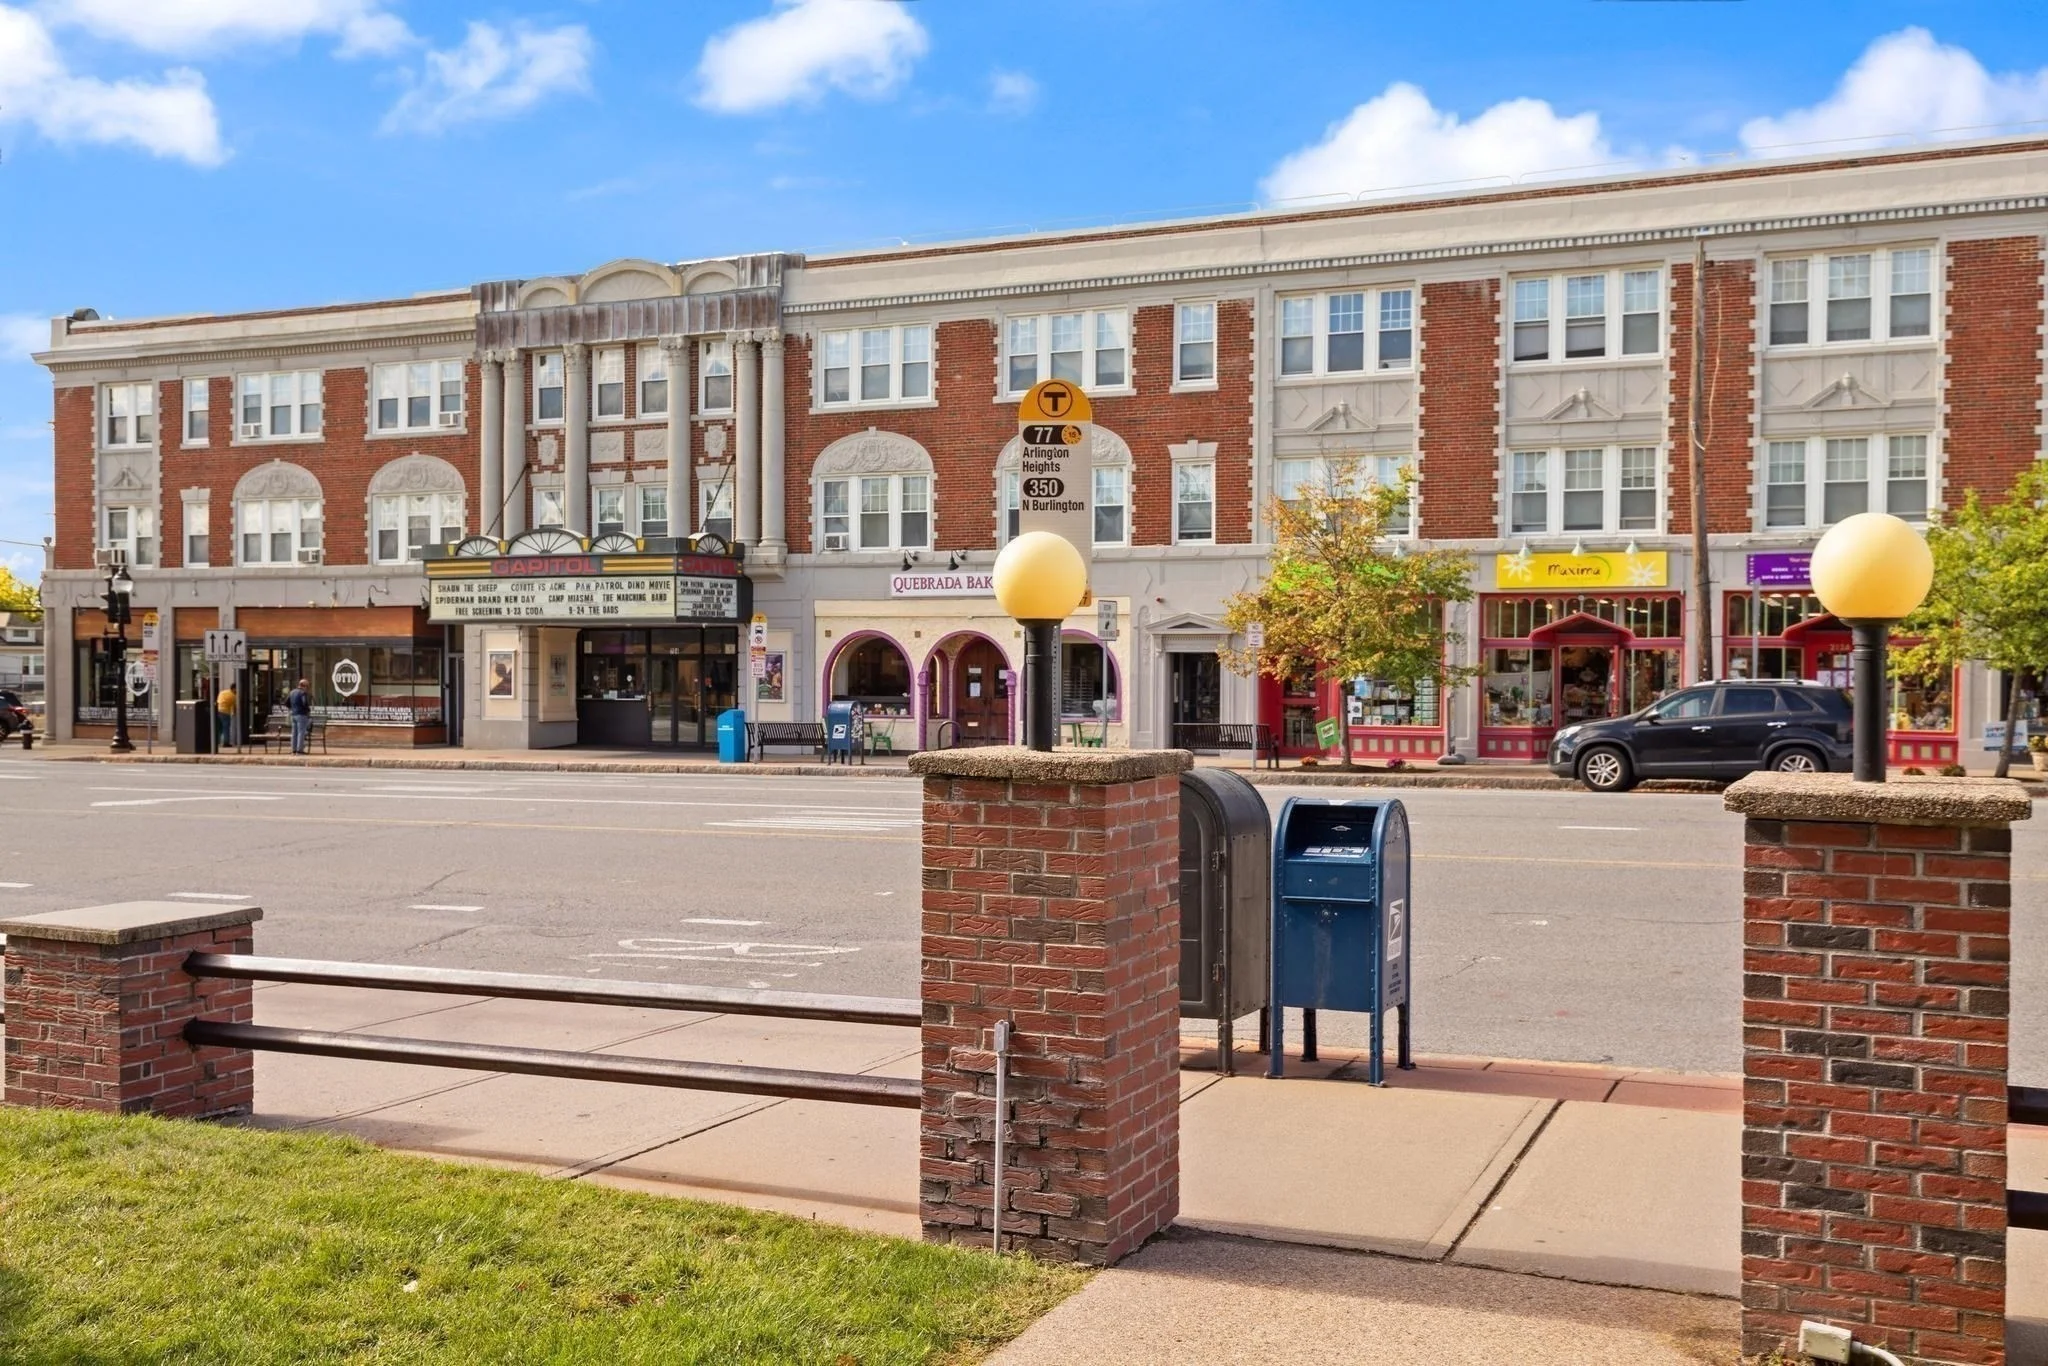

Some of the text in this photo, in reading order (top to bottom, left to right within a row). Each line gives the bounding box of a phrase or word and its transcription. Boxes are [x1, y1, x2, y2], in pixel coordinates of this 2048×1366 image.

[1043, 391, 1067, 412] T
[1034, 427, 1054, 443] 77
[1022, 447, 1069, 460] Arlington
[1022, 461, 1061, 474] Heights
[1029, 479, 1058, 497] 350
[1022, 500, 1084, 513] N Burlington
[492, 557, 597, 576] CAPITOL
[1548, 563, 1600, 577] Maxima
[438, 583, 460, 592] SHAUN
[464, 583, 474, 592] THE
[477, 583, 498, 592] SHEEP
[511, 583, 534, 592] COYOTE
[550, 582, 566, 591] ACME
[575, 582, 591, 591] PAW
[595, 580, 624, 590] PATROL
[627, 580, 645, 590] DINO
[649, 579, 671, 590] MOVIE
[893, 575, 994, 593] QUEBRADA BAK
[435, 592, 667, 605] SPIDERMAN BRAND NEW DAY CAMP MIASMA THE MARCHING BAND
[455, 607, 468, 616] FREE
[472, 607, 502, 616] SCREENING
[568, 606, 585, 615] 9-24
[588, 605, 600, 615] THE
[336, 672, 357, 683] OTTO
